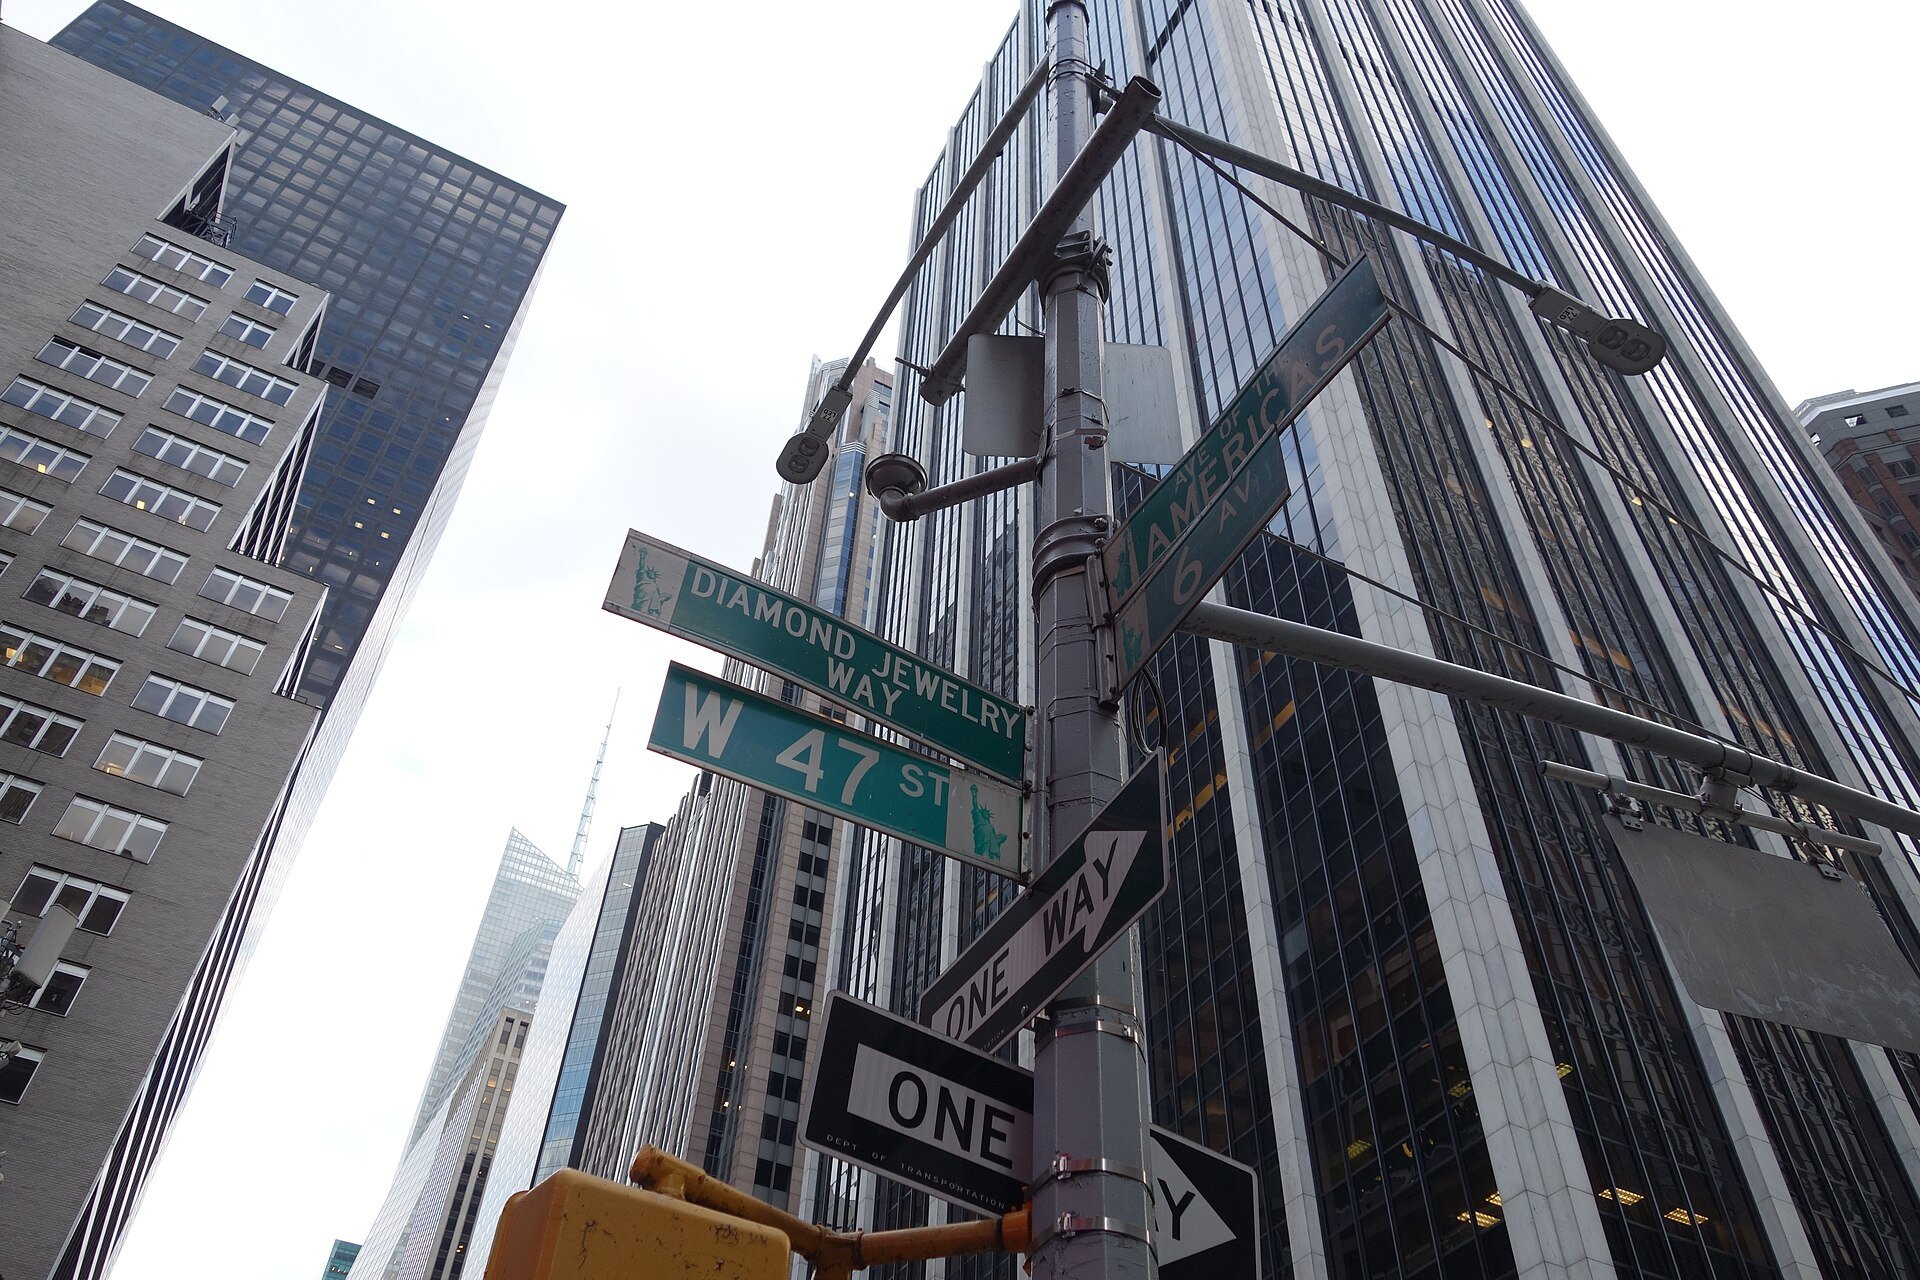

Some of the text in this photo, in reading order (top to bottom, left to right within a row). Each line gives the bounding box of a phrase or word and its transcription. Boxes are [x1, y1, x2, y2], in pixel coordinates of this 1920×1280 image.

[1559, 306, 1574, 320] LED
[1147, 323, 1345, 564] AMERICAS
[1174, 445, 1210, 494] AVE
[1219, 401, 1241, 440] OF
[1173, 469, 1251, 606] 6 AV
[690, 565, 1020, 740] DIAMOND JEWELRY
[827, 657, 903, 720] WAY
[683, 681, 951, 807] W 47 ST
[946, 836, 1119, 1041] ONE WAY
[826, 1133, 1006, 1210] DEPT OF TRANSPORTATION
[888, 1070, 1016, 1171] ONE
